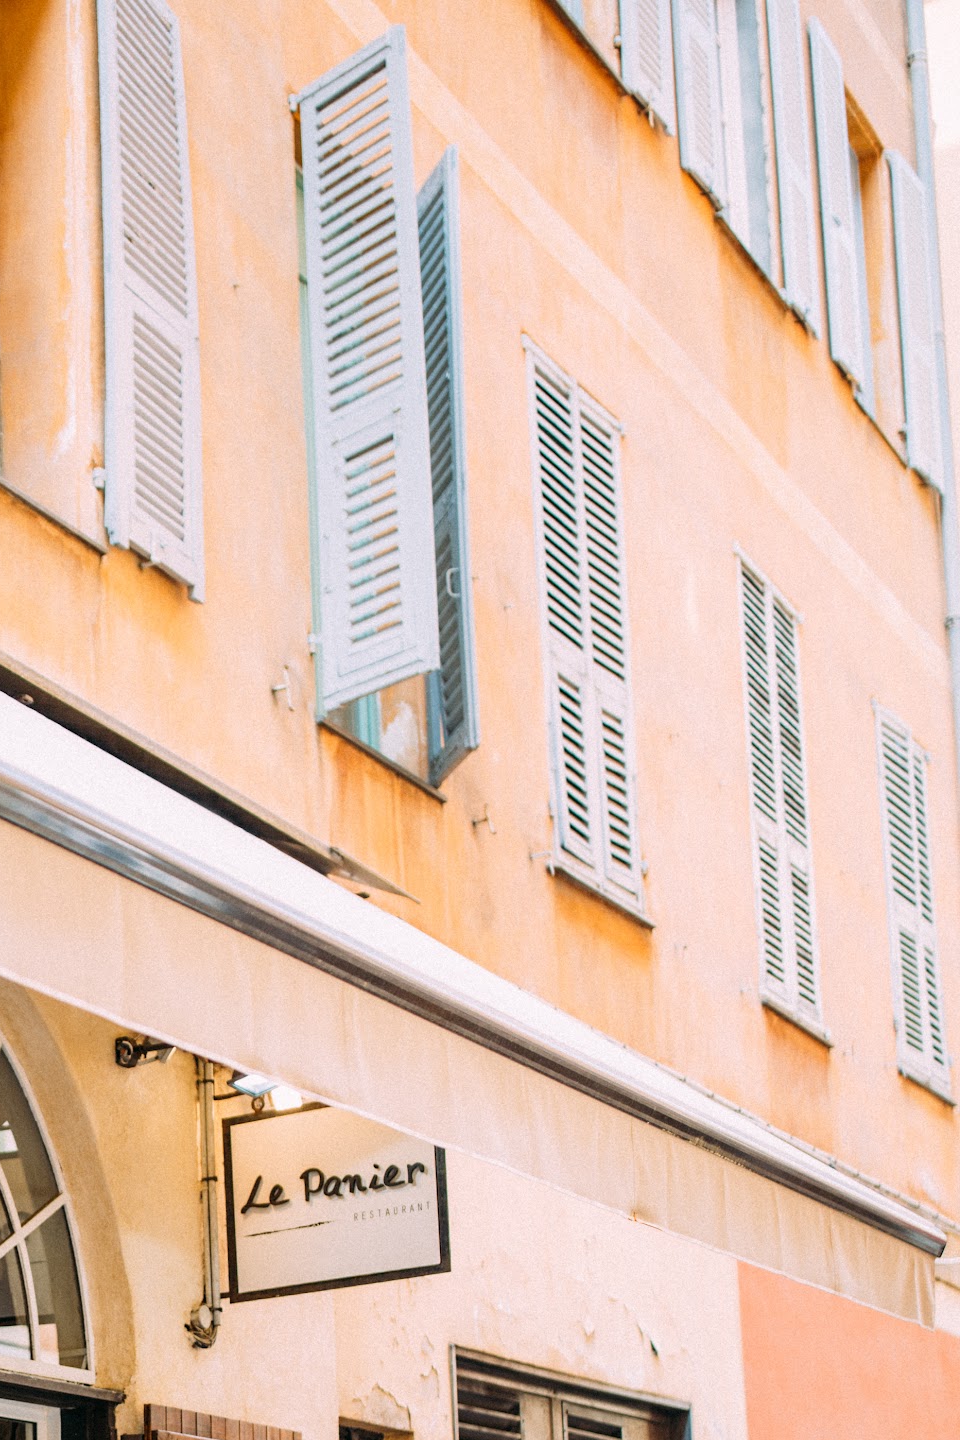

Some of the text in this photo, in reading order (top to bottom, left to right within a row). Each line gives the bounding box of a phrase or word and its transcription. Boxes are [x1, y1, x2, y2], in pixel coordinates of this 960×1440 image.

[240, 1161, 426, 1214] Le Panier
[353, 1201, 431, 1221] RESTAURANT
